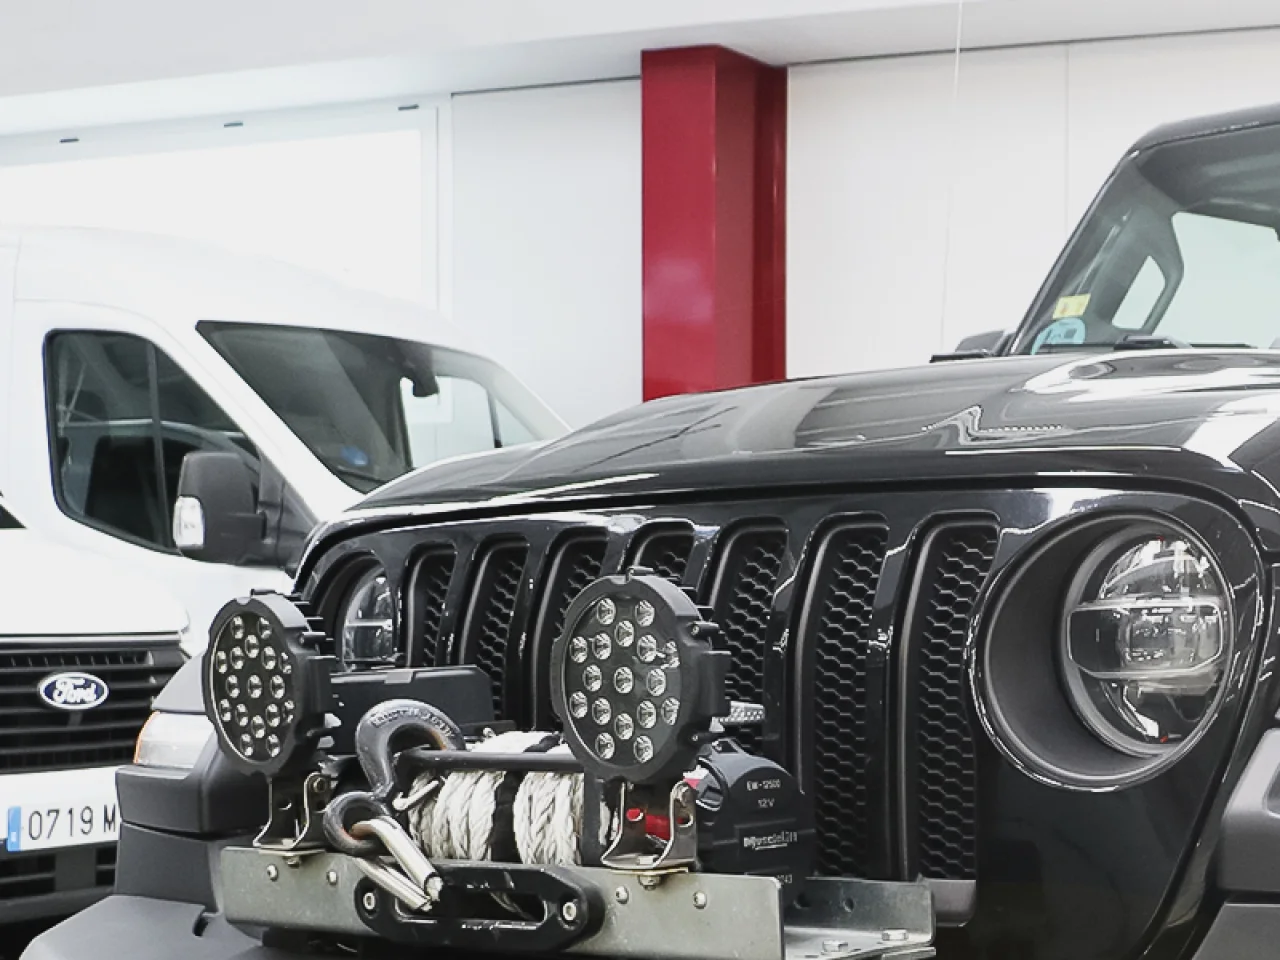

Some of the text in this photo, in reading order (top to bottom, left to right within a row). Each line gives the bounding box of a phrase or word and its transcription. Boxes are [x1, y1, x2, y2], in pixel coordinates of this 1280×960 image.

[53, 677, 97, 703] Ford
[28, 803, 117, 841] 0719 M
